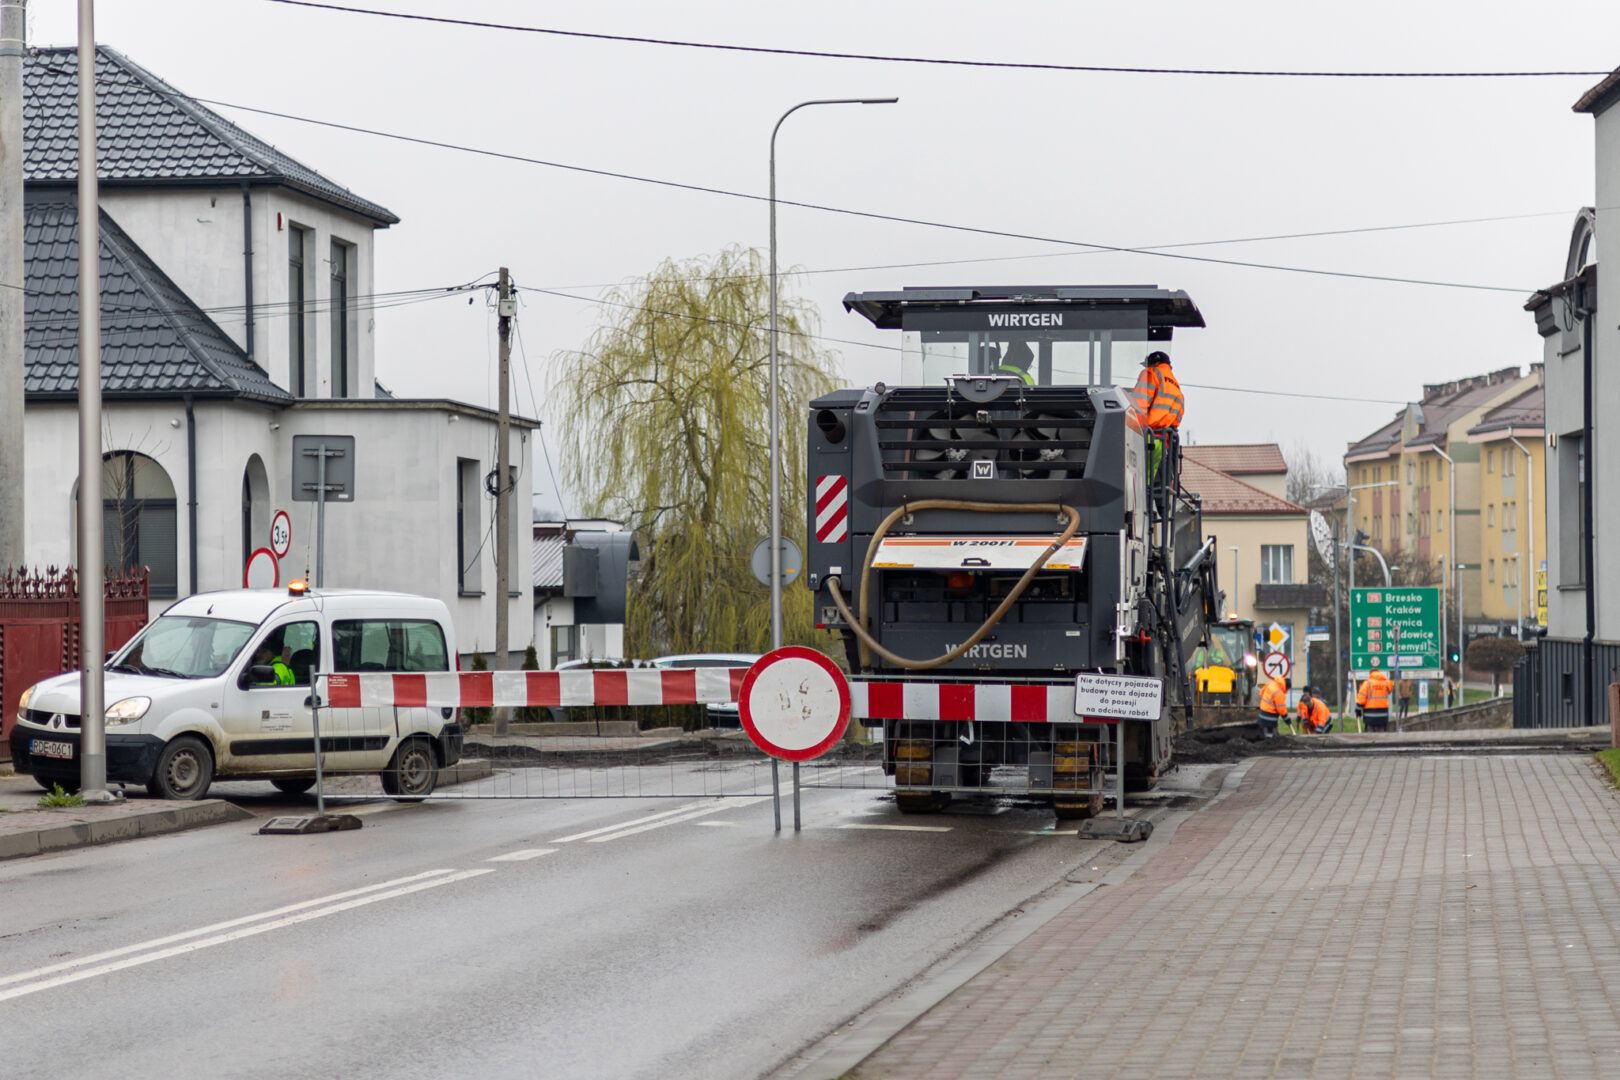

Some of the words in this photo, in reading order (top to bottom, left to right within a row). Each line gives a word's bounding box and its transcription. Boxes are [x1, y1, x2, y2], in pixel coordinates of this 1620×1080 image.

[988, 313, 1063, 327] WIRTGEN
[1385, 593, 1423, 602] Brzesko
[1385, 605, 1422, 614] Kraków
[1385, 617, 1423, 627] Krynica
[1386, 630, 1434, 639] Wdowice
[1095, 677, 1122, 687] dotyczy
[1124, 681, 1160, 689] pojazdów
[1080, 687, 1108, 696] budowy
[1128, 690, 1158, 698] dojazdu
[1111, 699, 1137, 707] posesji
[1098, 707, 1127, 715] odcinku
[33, 740, 49, 753] RDE
